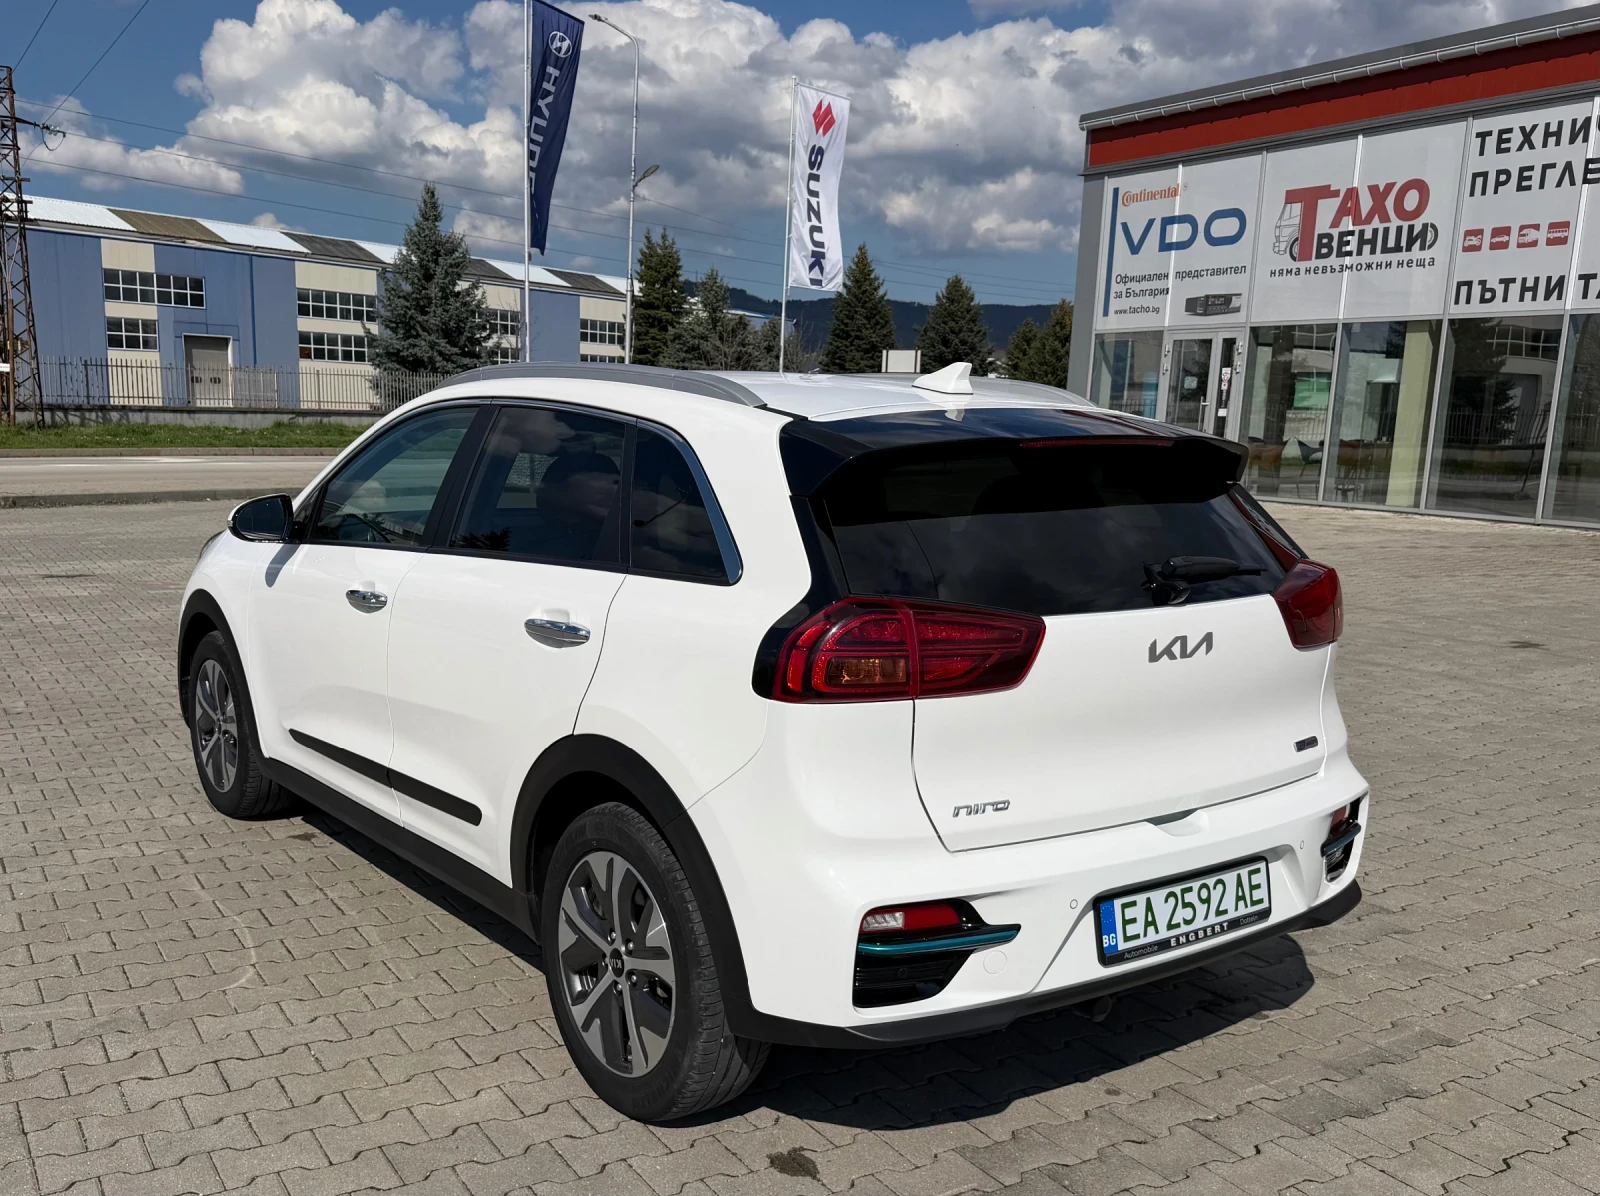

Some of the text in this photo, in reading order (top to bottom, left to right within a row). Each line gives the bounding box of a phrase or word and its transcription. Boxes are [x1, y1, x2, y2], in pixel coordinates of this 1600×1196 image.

[1475, 115, 1600, 157] ТЕХНИ
[1121, 182, 1180, 207] Continental
[807, 144, 826, 288] SUZUKI
[1120, 208, 1247, 256] VDO
[1115, 265, 1247, 287] Официален представител
[1270, 257, 1436, 278] няма невъзможни неща
[1114, 287, 1170, 299] за България
[1454, 273, 1600, 305] ПЪТНИ Т
[1114, 305, 1160, 315] www.tacho.bg
[1148, 632, 1214, 663] KIA
[1120, 867, 1265, 943] EA 2592 AE
[1102, 933, 1117, 948] BG
[1170, 922, 1229, 947] ENGBERT
